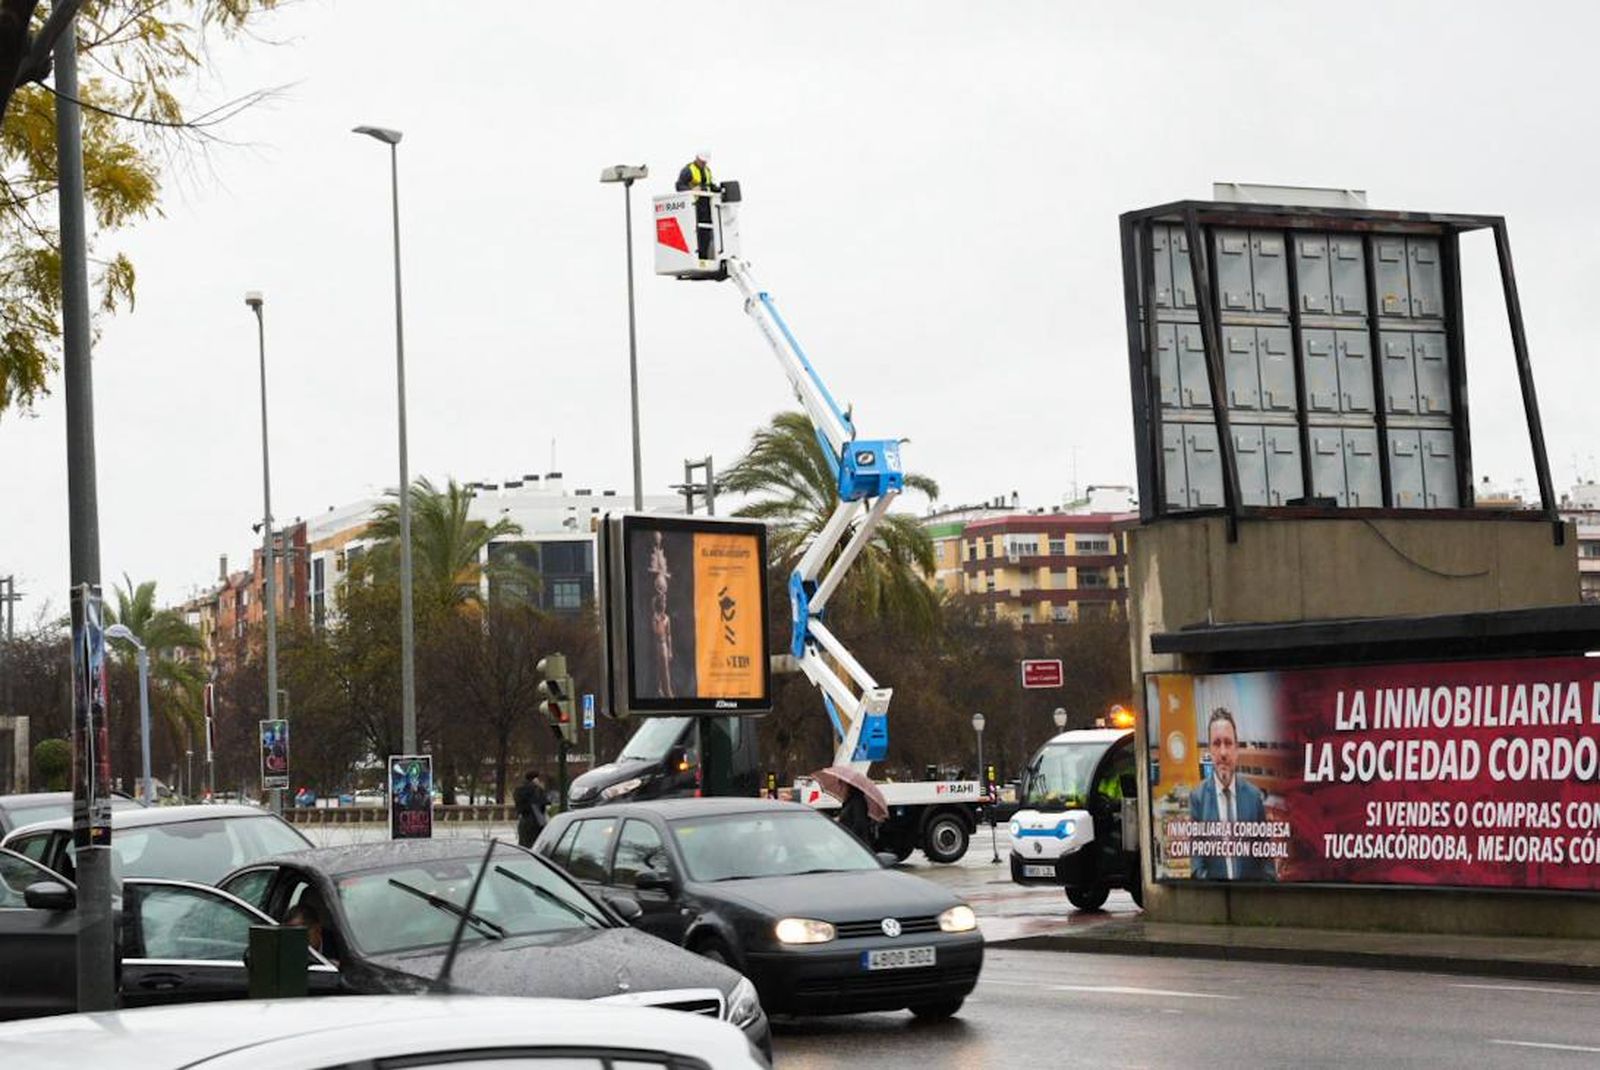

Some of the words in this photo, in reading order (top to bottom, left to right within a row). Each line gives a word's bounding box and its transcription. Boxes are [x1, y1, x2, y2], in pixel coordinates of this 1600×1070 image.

[1335, 690, 1367, 730] LA
[1373, 681, 1583, 729] INMOBILIARIA
[1304, 742, 1334, 782] LA
[1340, 738, 1481, 782] SOCIEDAD
[1488, 736, 1600, 781] CORDO
[950, 784, 973, 793] RAHI
[1366, 801, 1382, 827] SI
[1385, 801, 1451, 828] VENDES
[1454, 801, 1468, 828] O
[1472, 801, 1561, 829] COMPRAS
[1167, 821, 1232, 837] INMOBILIARIA
[1233, 821, 1290, 838] CORDOBESA
[1171, 841, 1191, 857] CON
[1192, 839, 1250, 857] PROYECCIÓN
[1252, 841, 1289, 858] GLOBAL
[1324, 828, 1473, 865] TUCASACÓRDOBA,
[1478, 835, 1565, 863] MEJORAS
[1568, 830, 1600, 864] CÓ
